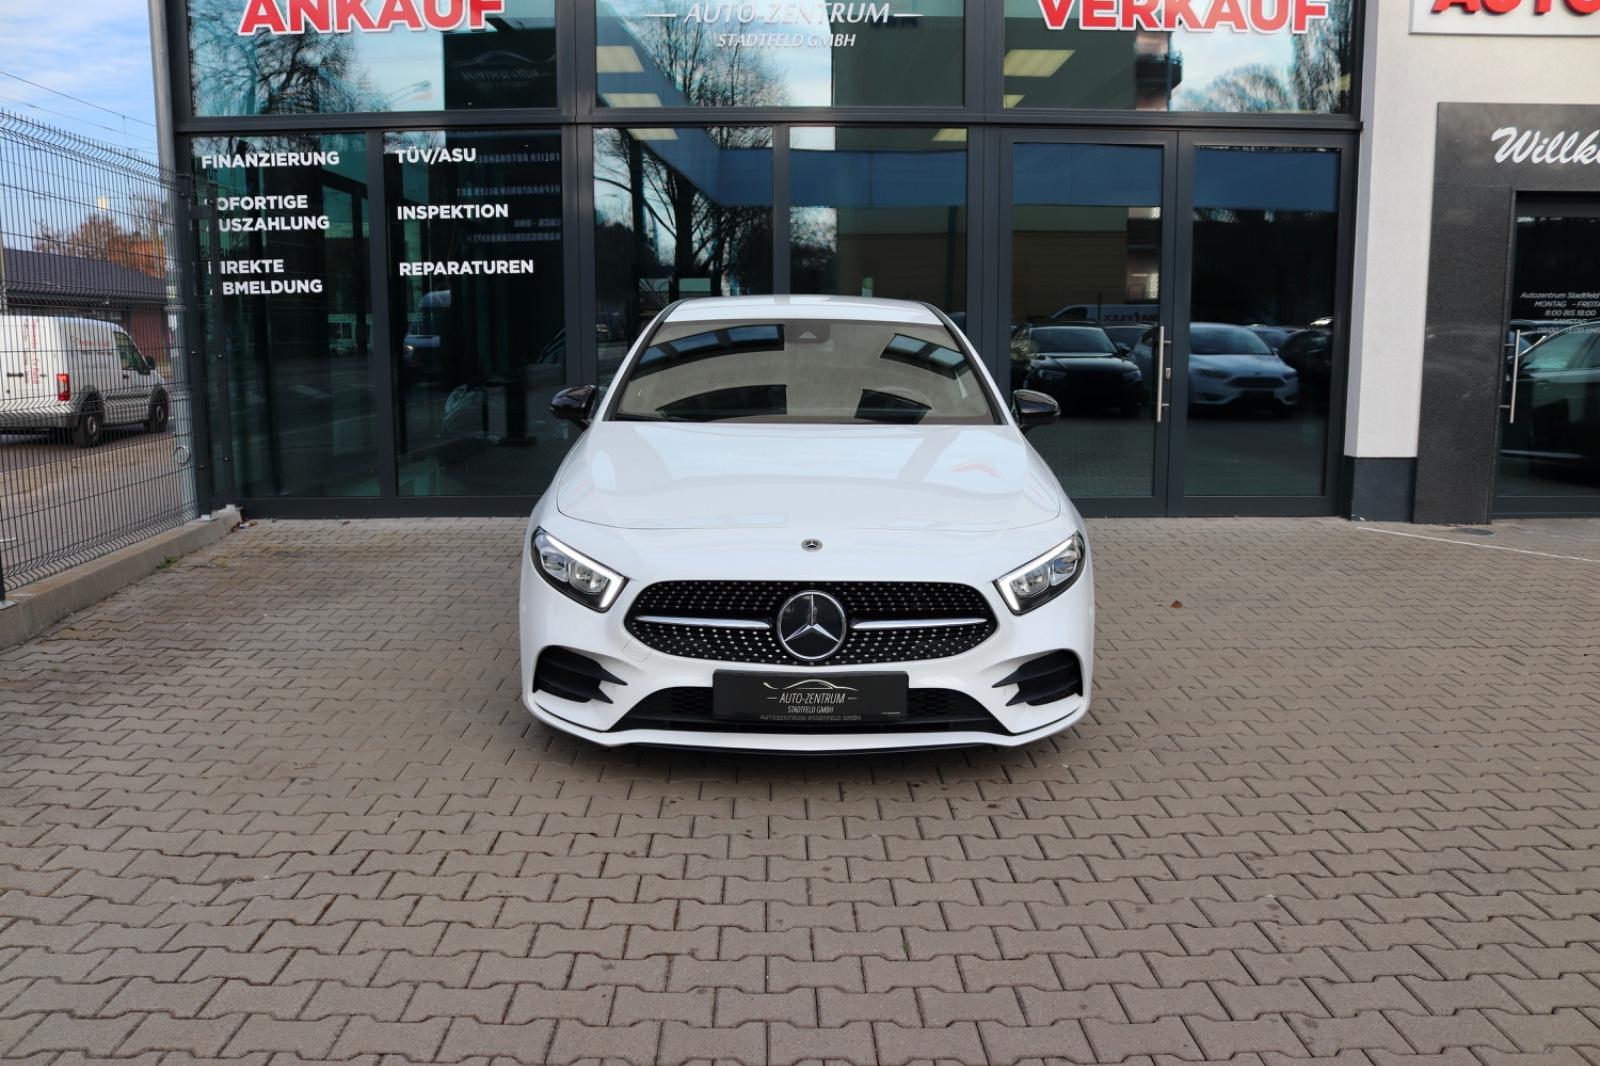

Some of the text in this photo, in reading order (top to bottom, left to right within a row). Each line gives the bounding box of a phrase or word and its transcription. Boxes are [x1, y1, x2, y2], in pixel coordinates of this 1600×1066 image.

[237, 0, 504, 35] ANKAUF
[685, 2, 891, 24] AUTO-ZENTRUM
[1037, 0, 1329, 34] VERKAUF
[717, 33, 804, 48] STADTFELD
[1490, 126, 1600, 165] Willk
[201, 151, 340, 169] FINANZIERUNG
[397, 146, 477, 165] TÜV/ASU
[204, 194, 309, 211] OFORTIGE
[397, 203, 509, 221] INSPEKTION
[206, 216, 331, 232] USZAHLUNG
[399, 258, 535, 277] REPARATUREN
[210, 279, 324, 296] BMELDUNG
[1534, 300, 1567, 308] MONTAG
[1562, 309, 1576, 317] BIS
[779, 692, 846, 704] AUTO-ZENTRUM
[787, 705, 815, 714] STADTFELD
